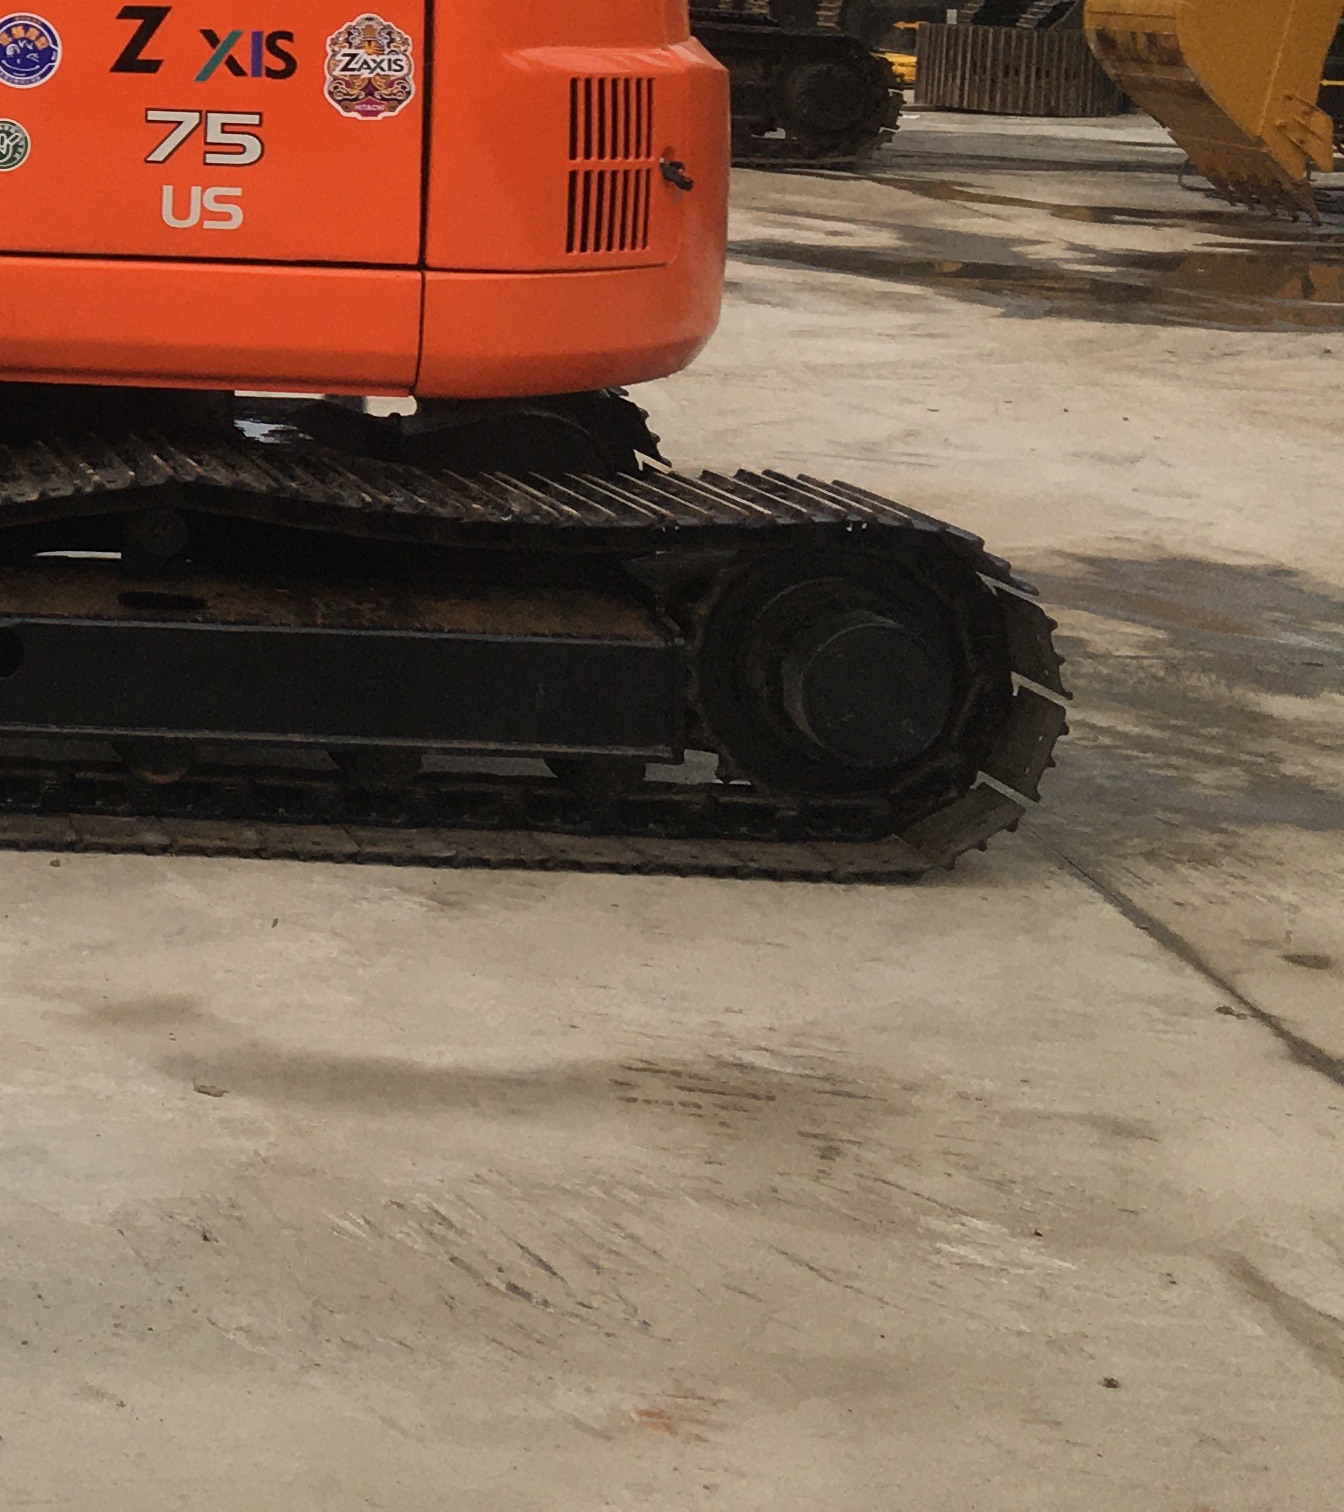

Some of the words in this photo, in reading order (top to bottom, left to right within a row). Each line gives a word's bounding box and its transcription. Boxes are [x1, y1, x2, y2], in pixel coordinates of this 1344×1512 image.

[339, 52, 405, 75] ZAXIS
[144, 108, 264, 167] 75
[162, 184, 244, 230] US
